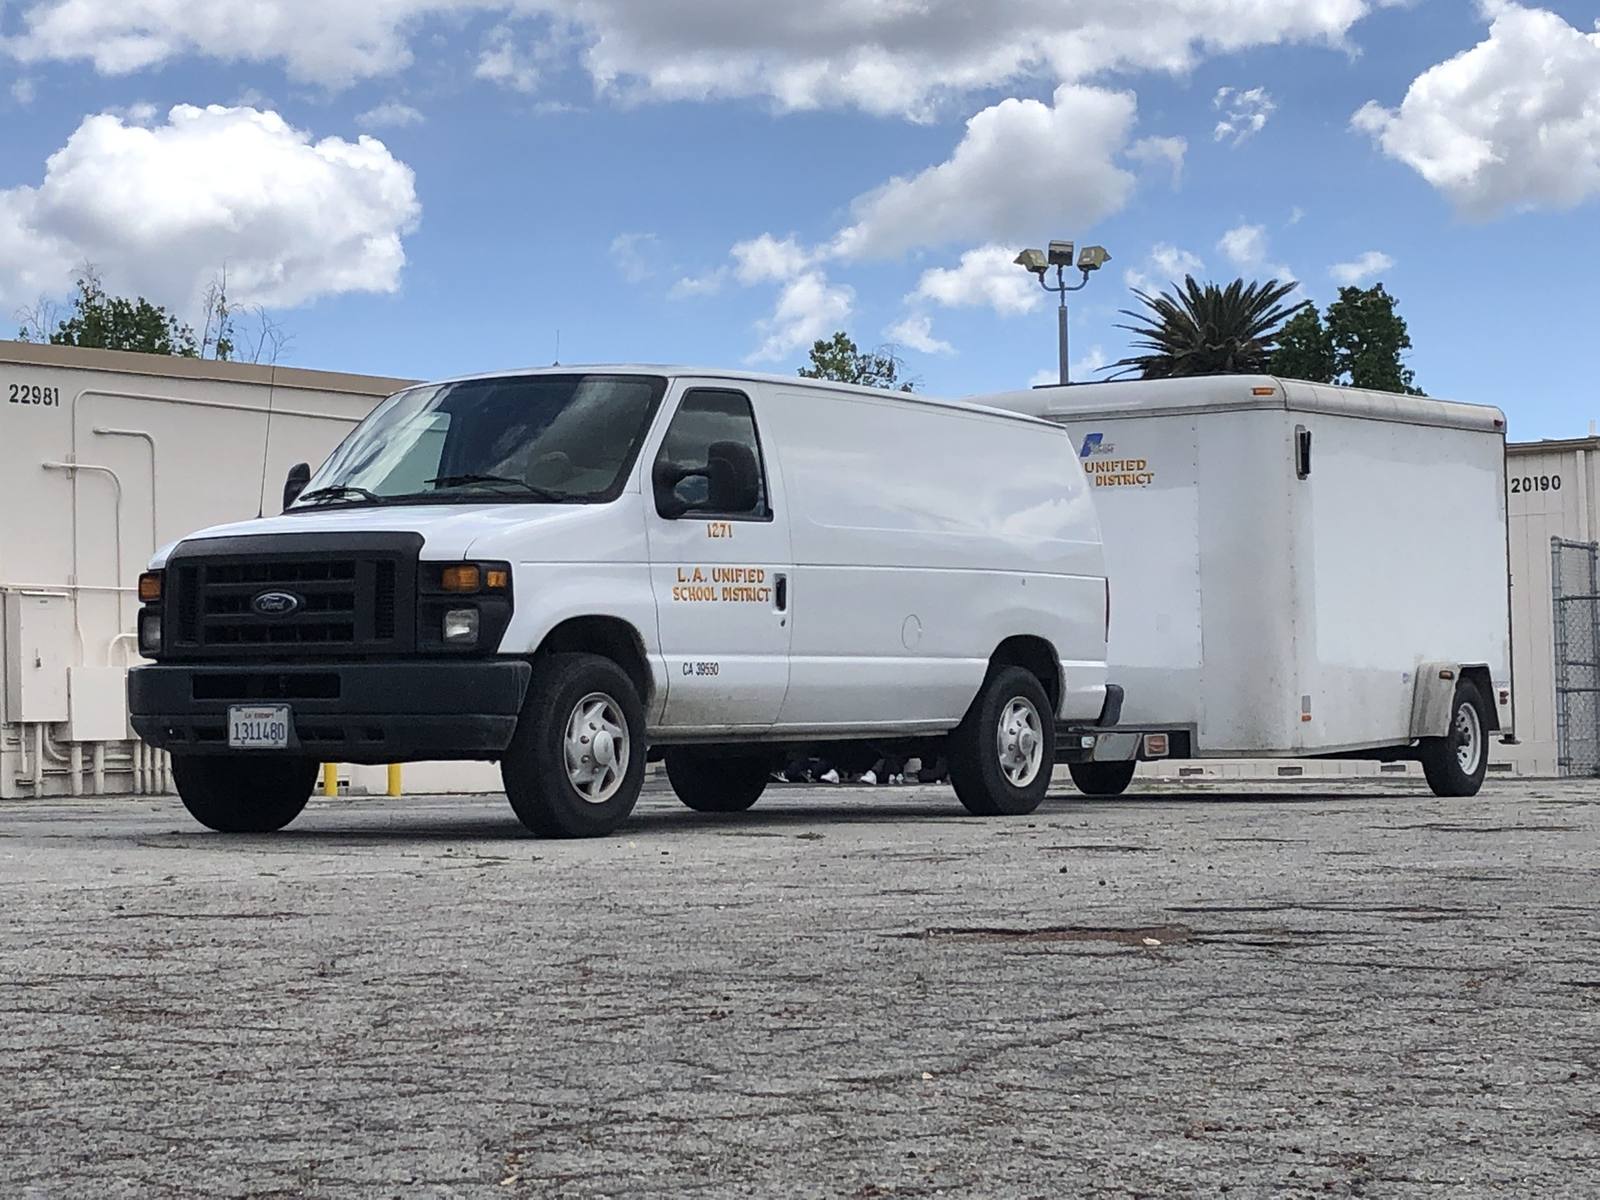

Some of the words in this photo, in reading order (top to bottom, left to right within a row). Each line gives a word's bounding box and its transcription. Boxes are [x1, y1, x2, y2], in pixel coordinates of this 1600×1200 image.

[9, 384, 59, 407] 22981
[1084, 459, 1147, 473] UNIFIED
[1095, 473, 1155, 487] DISTRICT
[1511, 475, 1562, 493] 20190
[707, 523, 733, 538] 1271
[712, 568, 765, 584] UNIFIED
[672, 586, 718, 601] SCHOOL
[722, 587, 771, 602] DISTRICT
[261, 595, 287, 610] Ford
[682, 662, 693, 676] CA
[696, 662, 719, 676] 39550
[233, 722, 285, 740] 1311480
